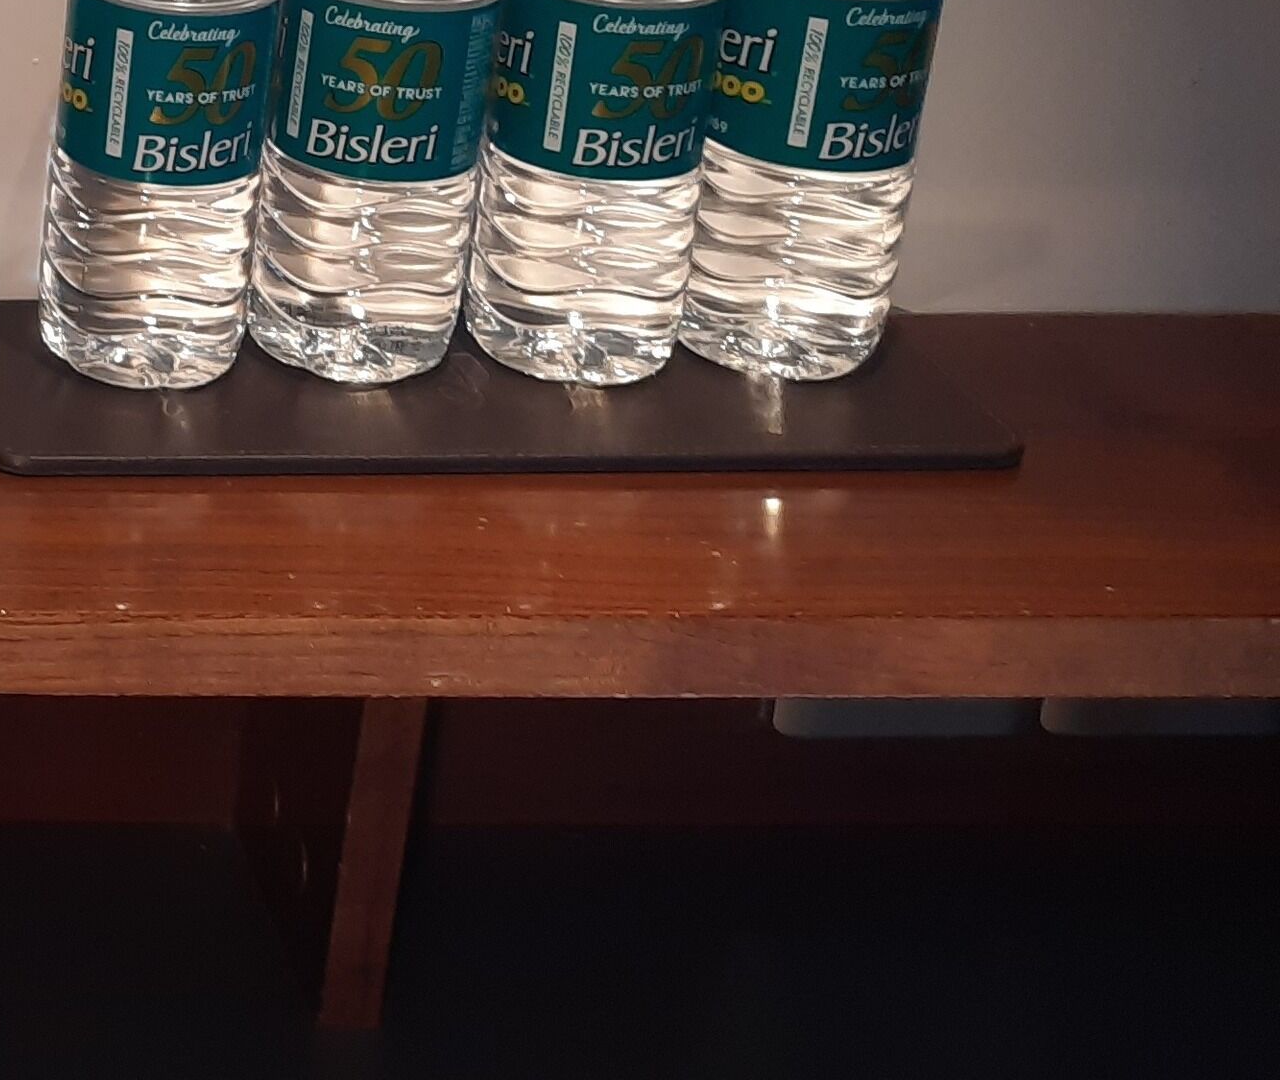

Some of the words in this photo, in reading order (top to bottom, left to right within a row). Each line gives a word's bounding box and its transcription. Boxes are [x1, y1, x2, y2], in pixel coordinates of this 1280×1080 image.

[148, 20, 240, 47] Celebrating
[325, 5, 420, 43] Celebrating
[592, 14, 689, 41] Celebrating
[146, 88, 194, 104] YEARS
[198, 92, 218, 104] OF
[222, 84, 256, 103] TRUST
[149, 41, 256, 126] 50
[321, 73, 365, 94] YEARS
[369, 85, 391, 98] OF
[396, 87, 443, 100] TRUST
[323, 36, 444, 120] 50
[590, 82, 638, 98] YEARS
[643, 86, 664, 98] OF
[668, 79, 703, 97] TRUST
[591, 36, 704, 118] 50
[840, 76, 887, 89] YEARS
[549, 71, 567, 139] RECYCLABLE
[132, 120, 253, 172] Bisleri
[305, 118, 441, 165] Bisleri
[572, 116, 698, 167] Bisleri
